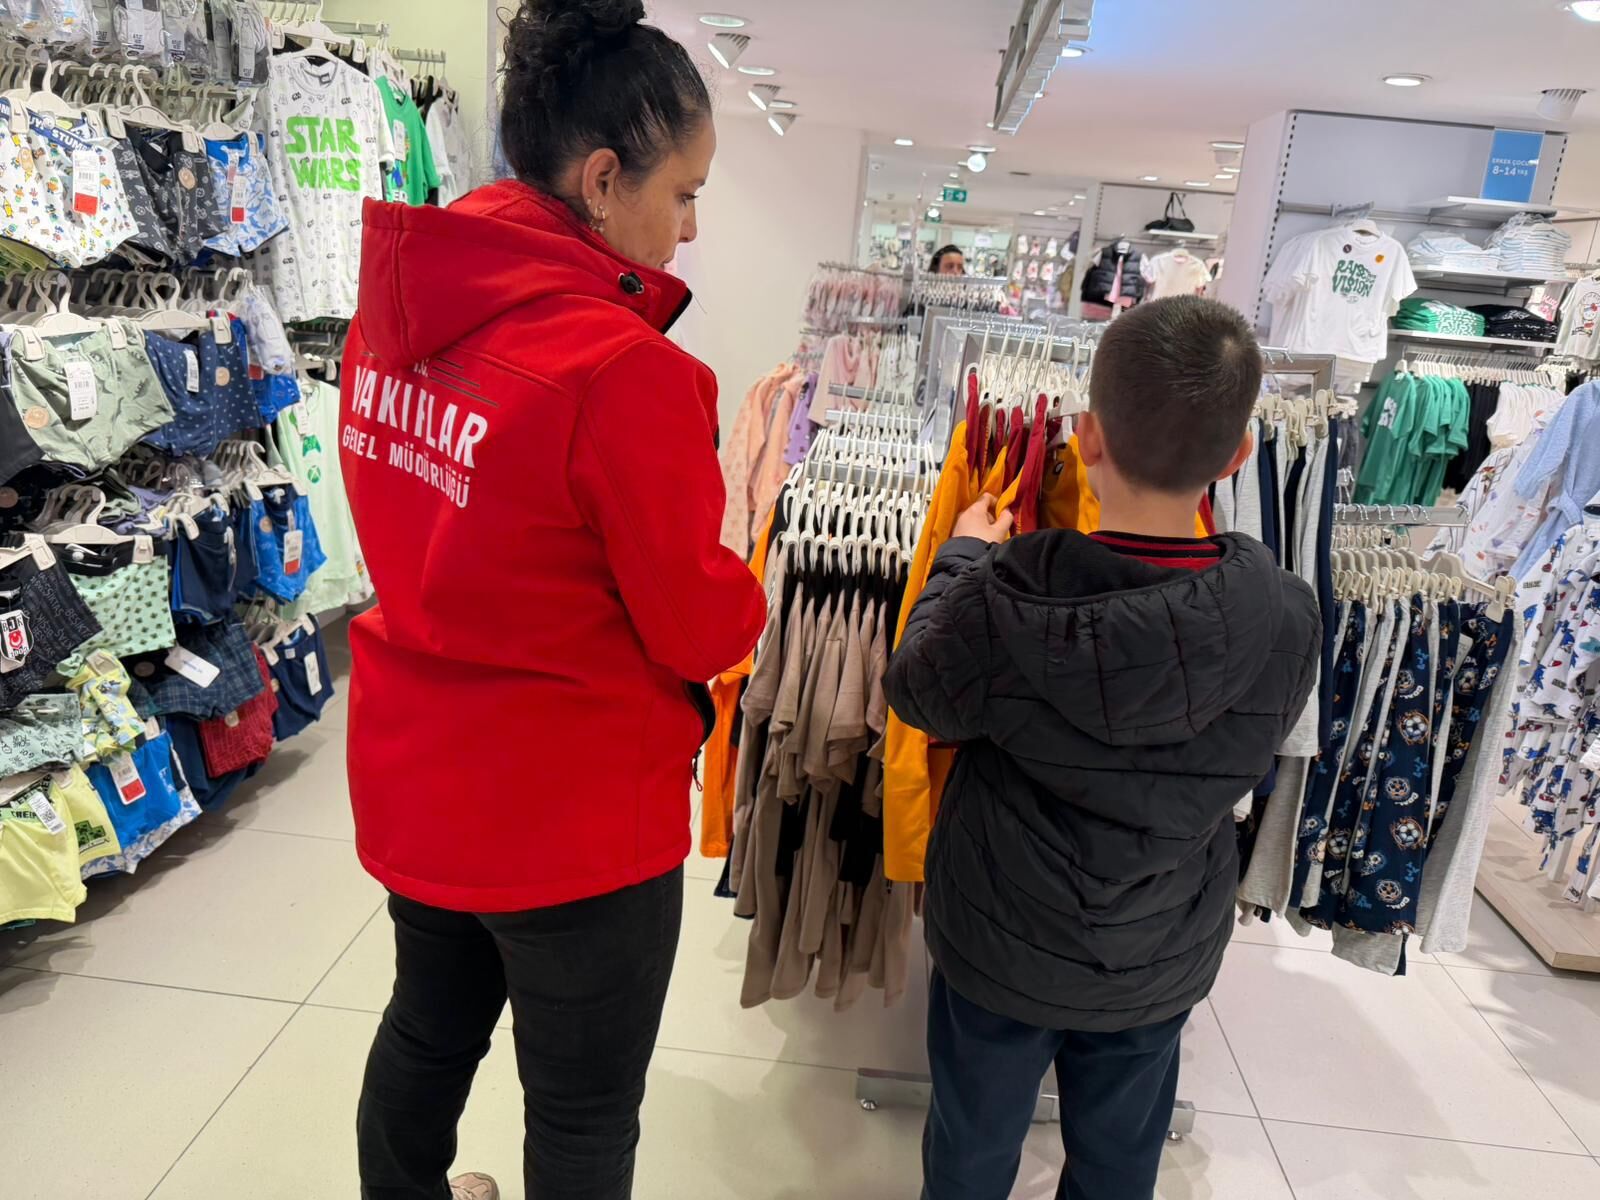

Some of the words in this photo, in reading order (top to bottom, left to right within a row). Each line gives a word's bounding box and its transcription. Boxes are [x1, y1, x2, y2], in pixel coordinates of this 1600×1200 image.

[285, 116, 361, 154] STAR
[287, 157, 362, 192] WARS
[1492, 165, 1516, 177] 8-14
[1332, 275, 1373, 299] VISION
